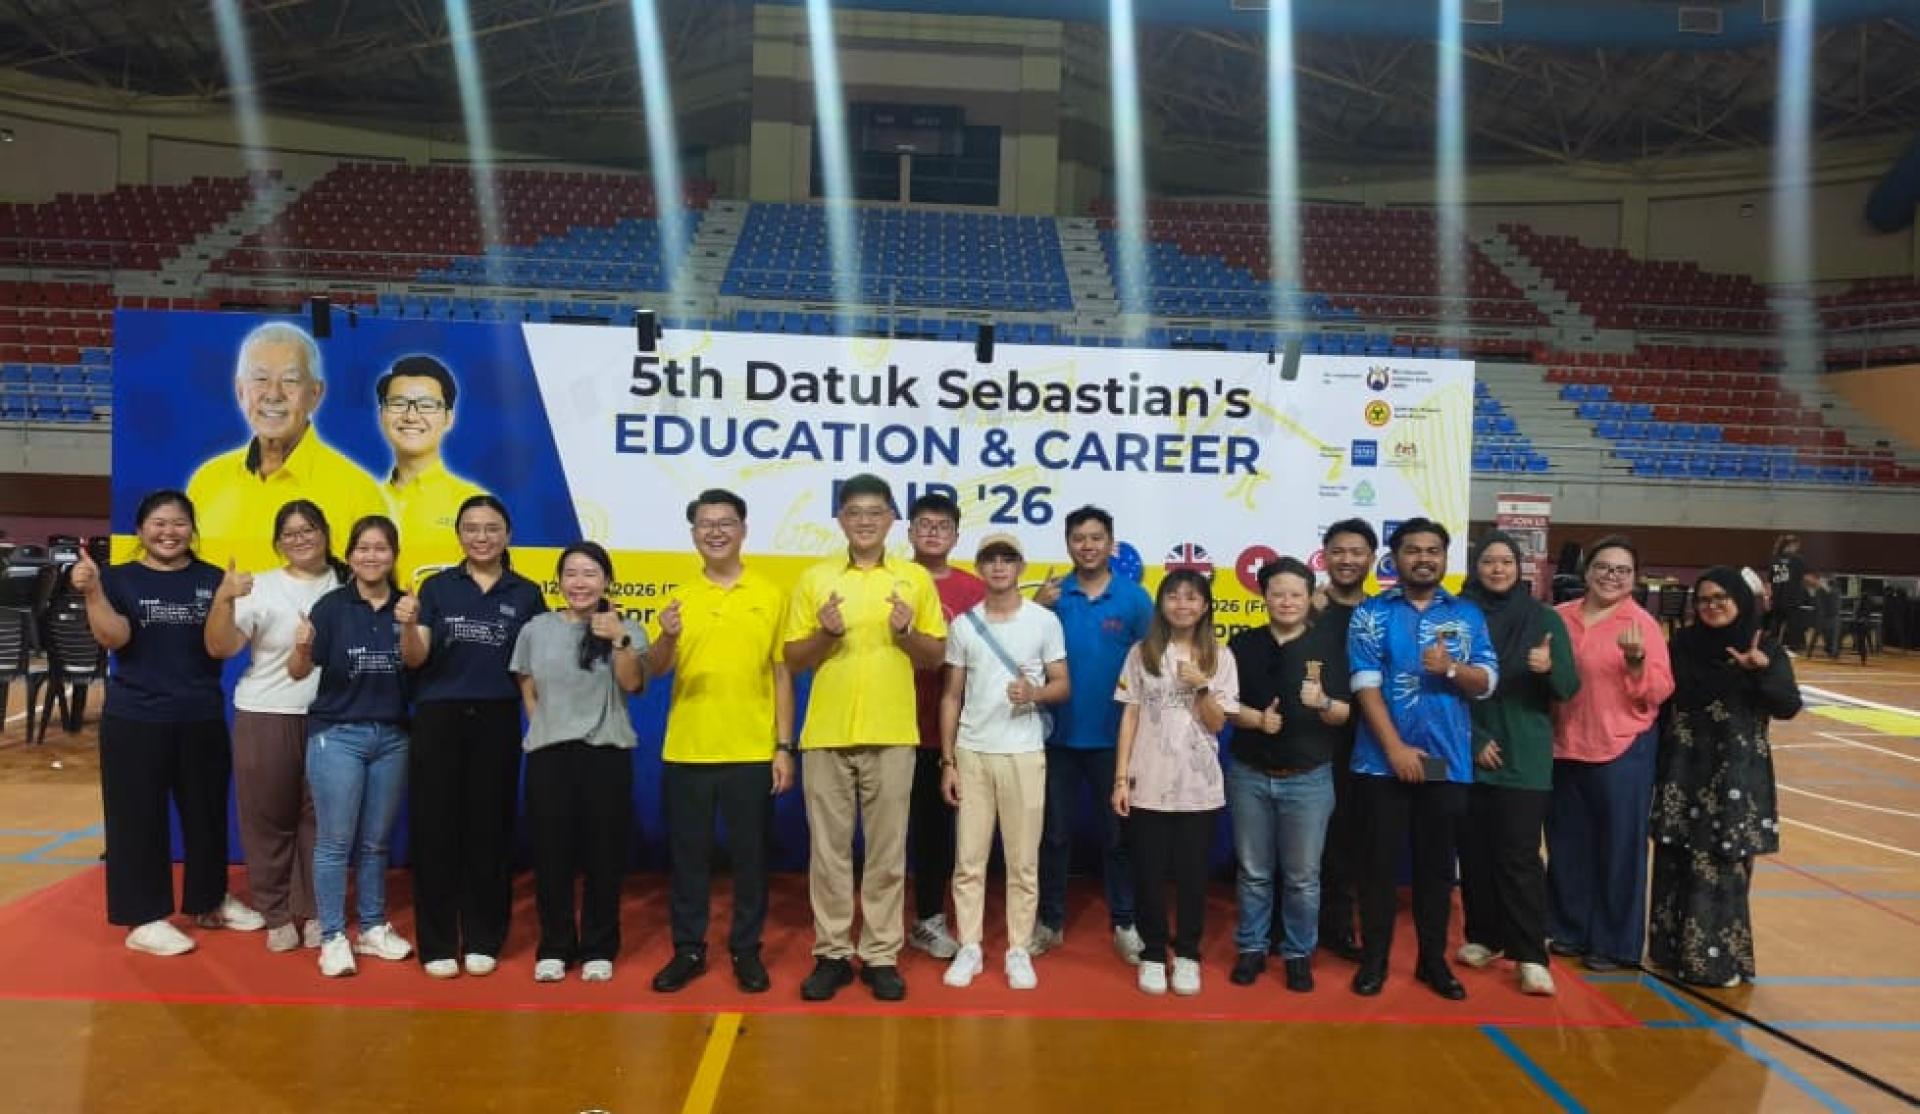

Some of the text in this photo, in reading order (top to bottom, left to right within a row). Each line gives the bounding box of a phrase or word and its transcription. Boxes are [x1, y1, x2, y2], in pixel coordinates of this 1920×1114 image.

[629, 355, 1251, 419] 5th Datuk Sebastian's
[615, 412, 1260, 476] EDUCATION & CAREER
[831, 480, 1054, 526] FIR '26
